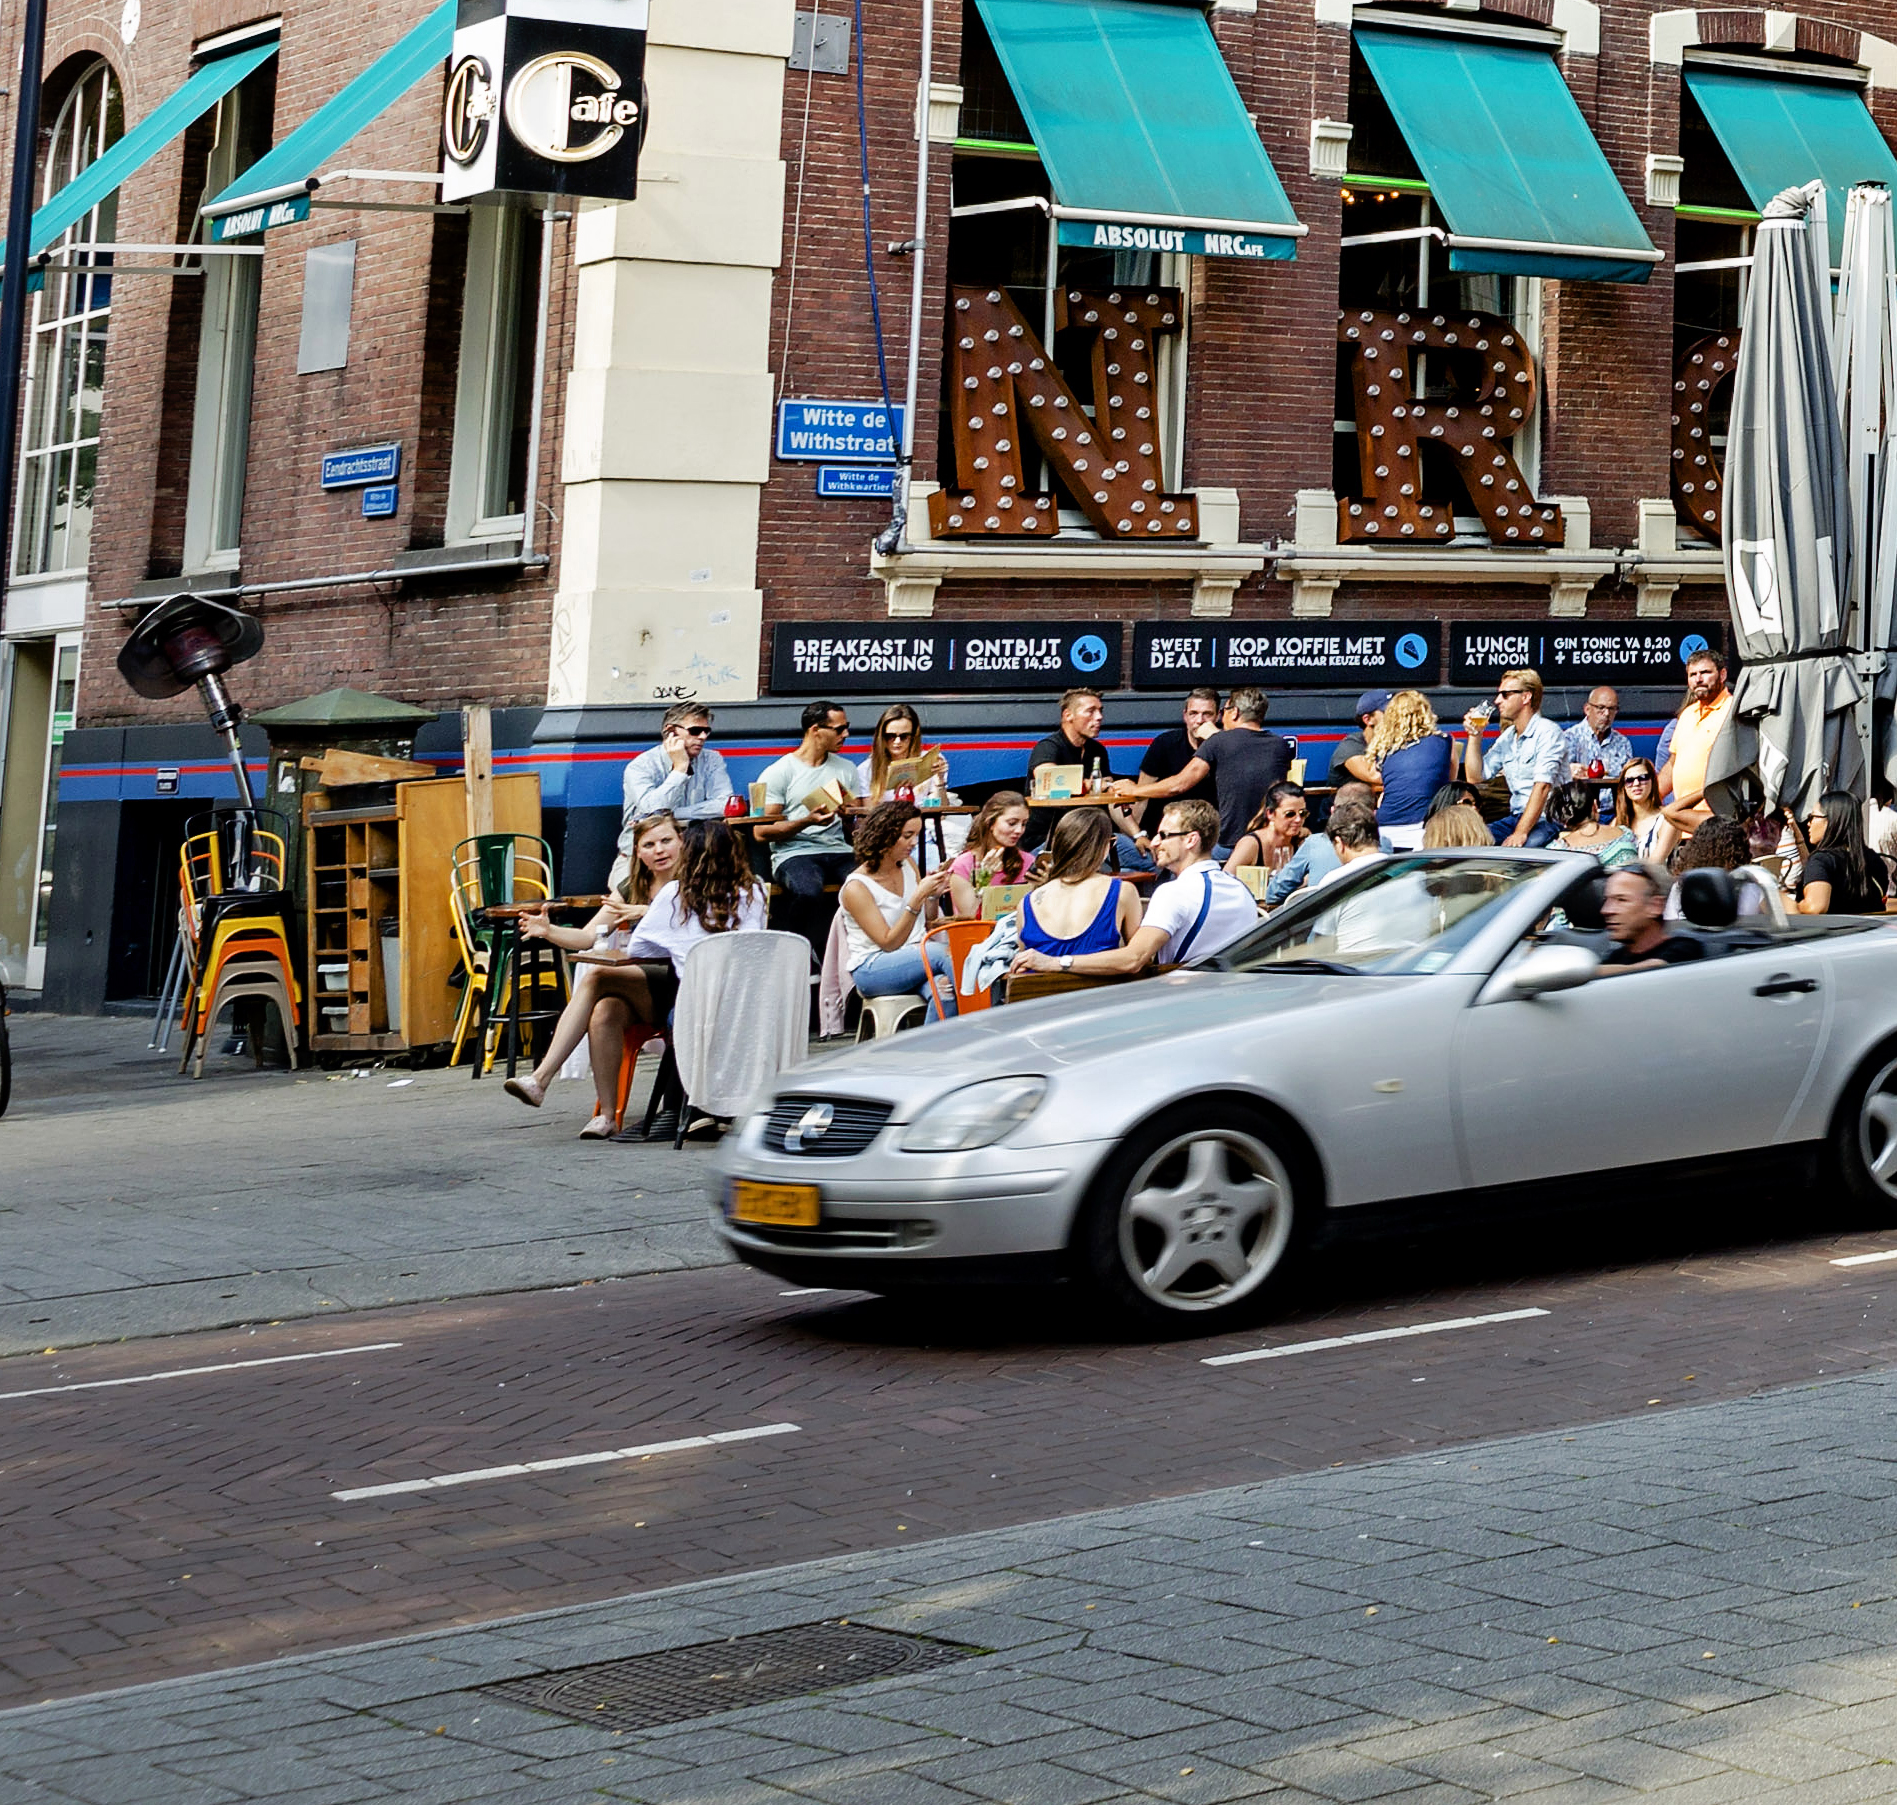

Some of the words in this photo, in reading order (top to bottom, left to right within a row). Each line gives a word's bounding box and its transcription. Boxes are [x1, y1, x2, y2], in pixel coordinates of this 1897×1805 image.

[1093, 224, 1186, 252] ABSOLUT
[803, 407, 856, 426] Witte
[862, 411, 886, 428] de
[790, 431, 896, 452] Withstraat
[839, 472, 865, 481] Witte
[867, 473, 879, 481] de
[827, 482, 890, 492] Withkwartier
[793, 638, 907, 657] BREAKFAST
[913, 638, 934, 656] IN
[966, 638, 1062, 657] ONTBIJT
[1151, 638, 1202, 652] SWEET
[1228, 637, 1270, 656] KOP
[1275, 637, 1340, 656] KOFFIE
[1346, 636, 1386, 655] MET
[1465, 636, 1529, 653] LUNCH
[1554, 637, 1579, 650] GIN
[1581, 637, 1621, 650] TONIC
[1624, 637, 1641, 650] VA
[1644, 637, 1671, 650] 8,20
[793, 656, 831, 673] THE
[837, 655, 933, 673] MORNING
[965, 656, 1020, 671] DELUXE
[1023, 656, 1062, 671] 14,50
[1150, 652, 1202, 668] DEAL
[1228, 656, 1248, 668] EEN
[1251, 656, 1296, 667] TAARTJE
[1297, 655, 1327, 666] NAAR
[1328, 655, 1361, 666] KEUZE
[1362, 655, 1386, 666] 6,00
[1465, 653, 1486, 666] AT
[1488, 653, 1529, 665] NOON
[1572, 651, 1639, 664] EGGSLUT
[1643, 651, 1671, 664] 7,00
